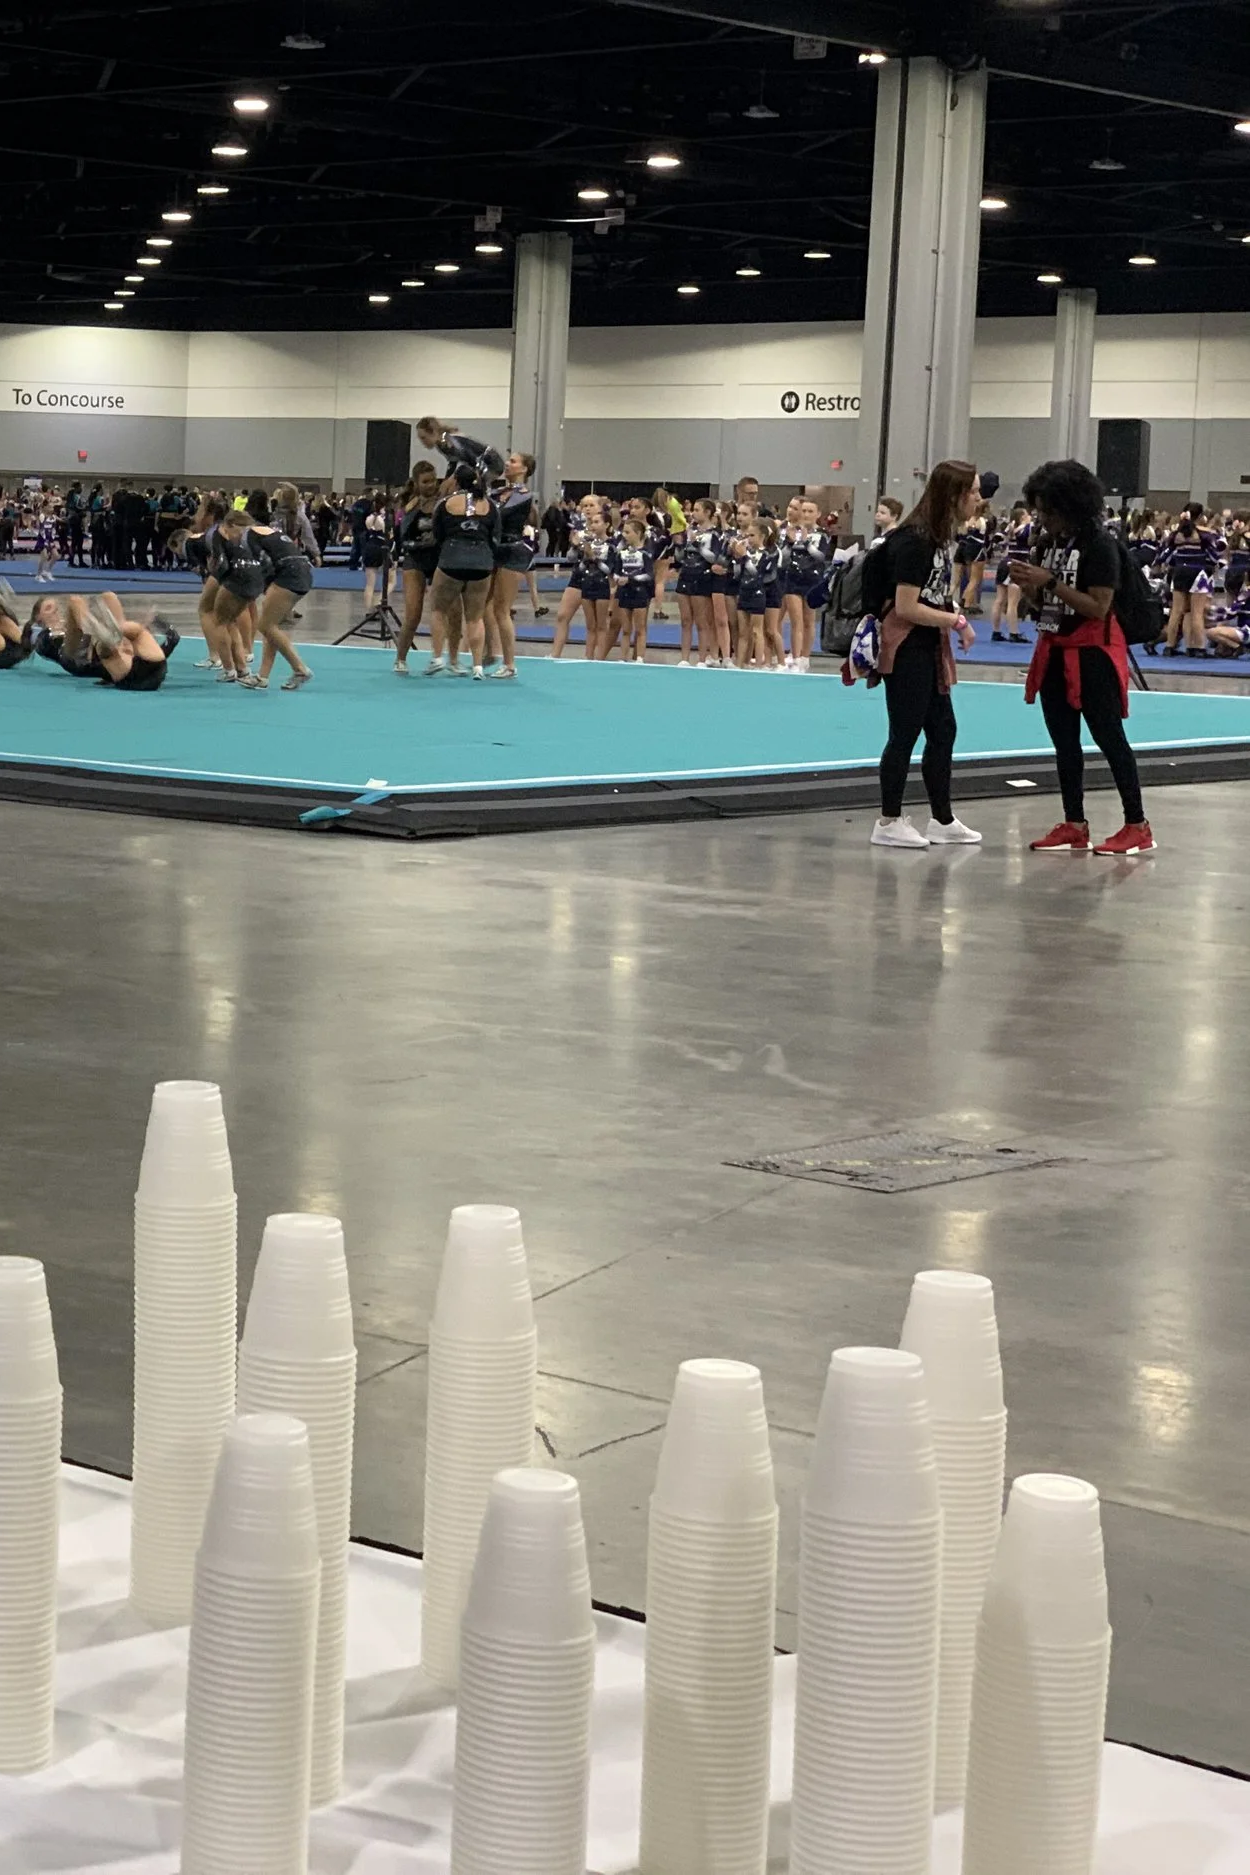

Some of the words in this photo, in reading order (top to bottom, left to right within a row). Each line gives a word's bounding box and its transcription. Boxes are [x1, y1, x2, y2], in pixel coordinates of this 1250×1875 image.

[12, 388, 32, 406] To
[36, 389, 125, 408] Concourse
[805, 392, 861, 411] Restro
